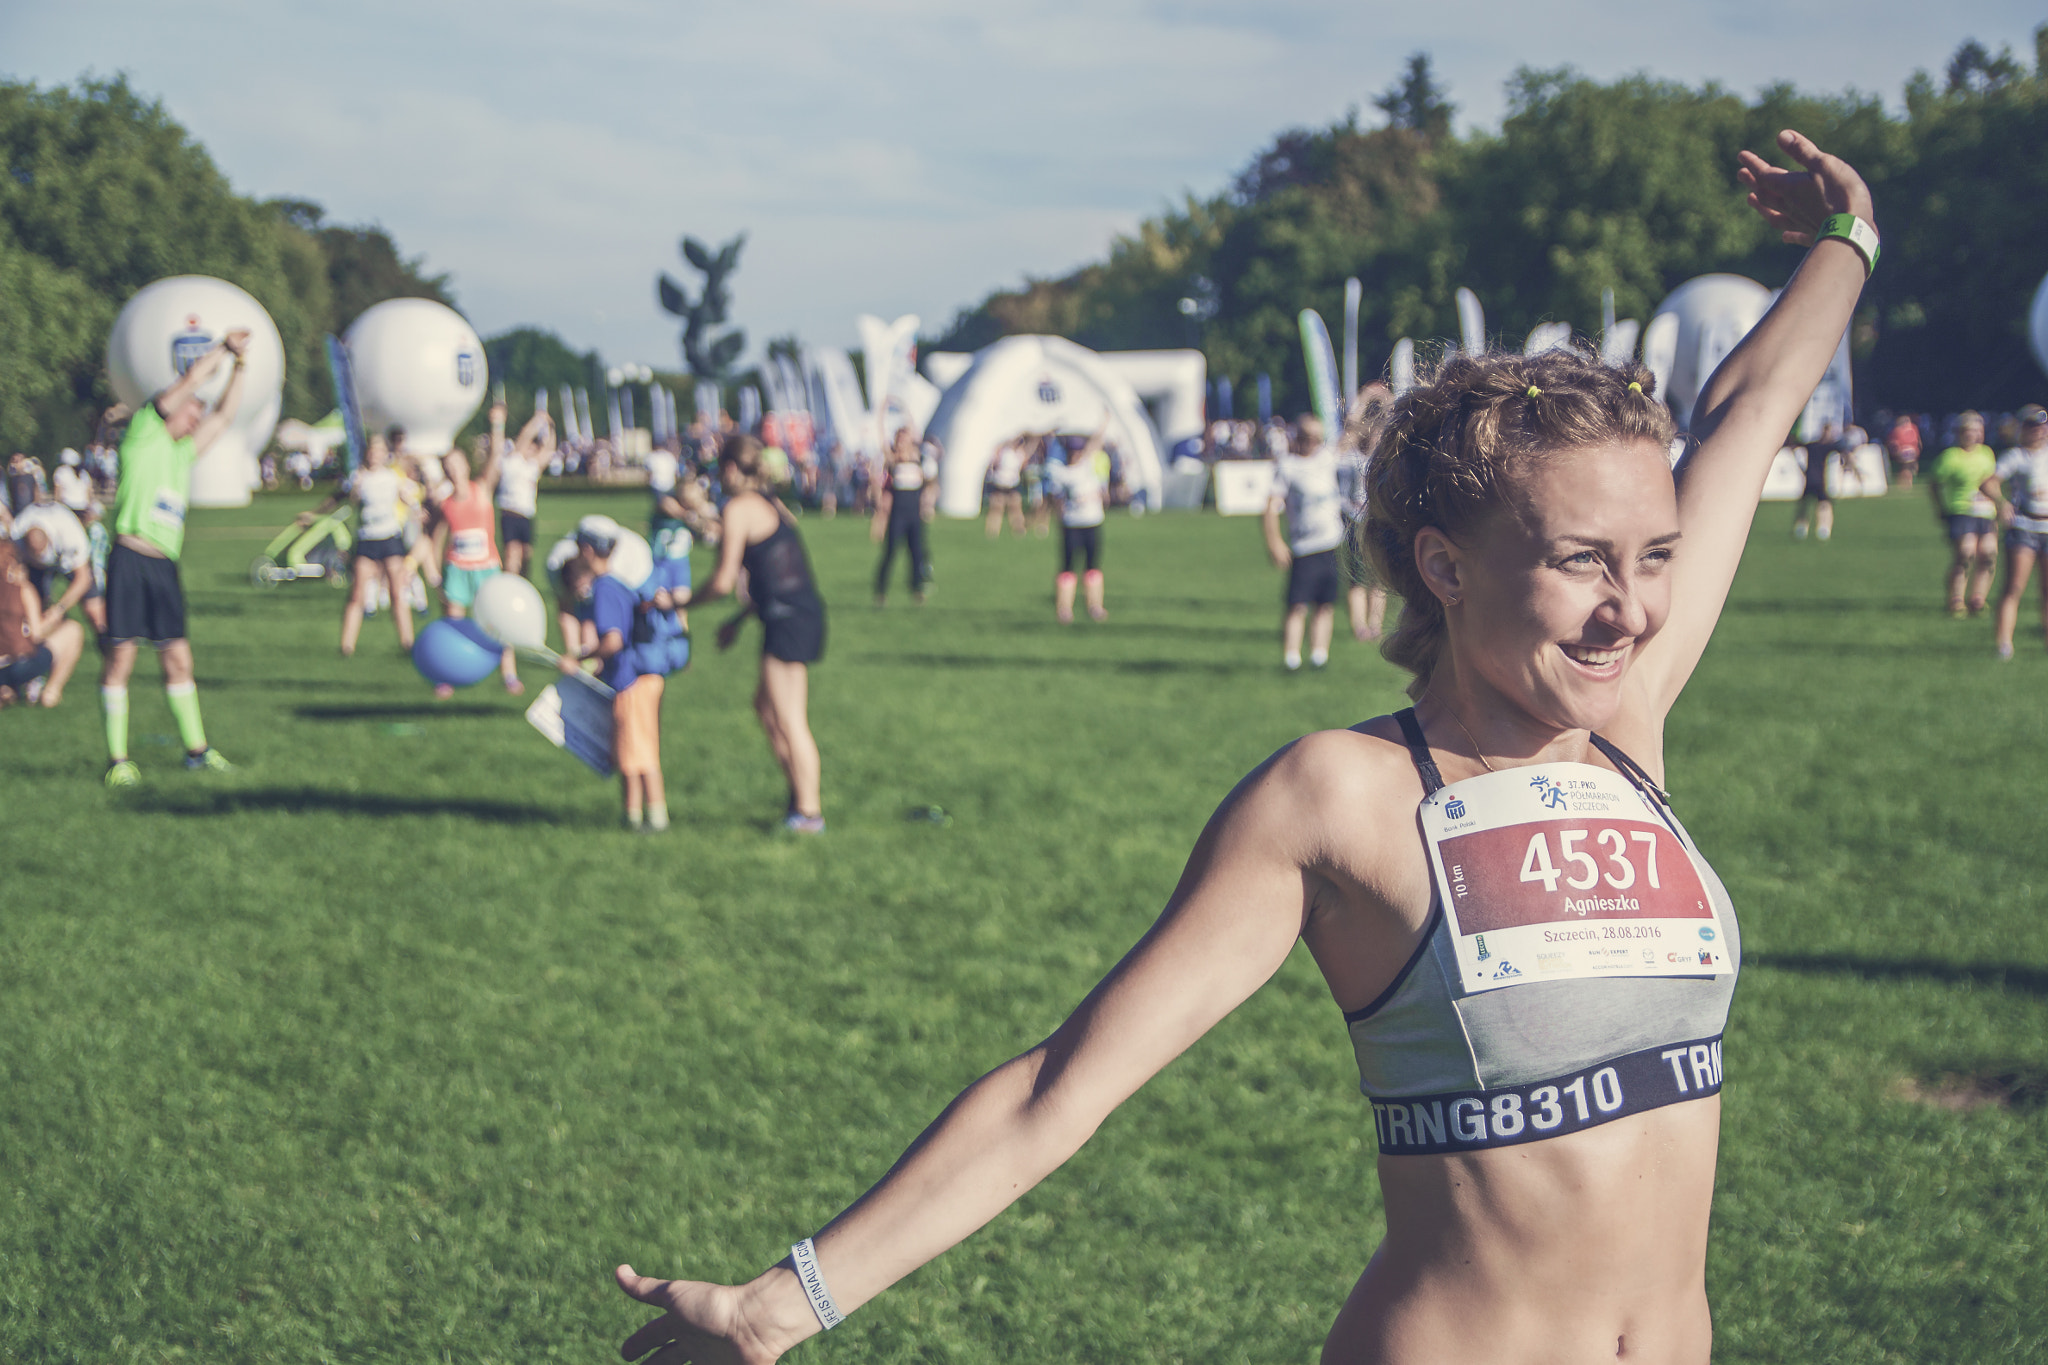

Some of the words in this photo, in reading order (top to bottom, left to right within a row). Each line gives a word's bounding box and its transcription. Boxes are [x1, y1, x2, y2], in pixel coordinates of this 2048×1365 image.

[1572, 801, 1609, 811] SZCZECIN
[1519, 828, 1661, 892] 4537
[1452, 864, 1465, 883] km
[1455, 884, 1469, 899] 10
[1564, 894, 1640, 916] Agnieszka
[1543, 928, 1601, 943] Szczecin,
[1601, 926, 1662, 940] 28.08.2016
[800, 1259, 827, 1301] FINALLY
[817, 1299, 832, 1312] IS
